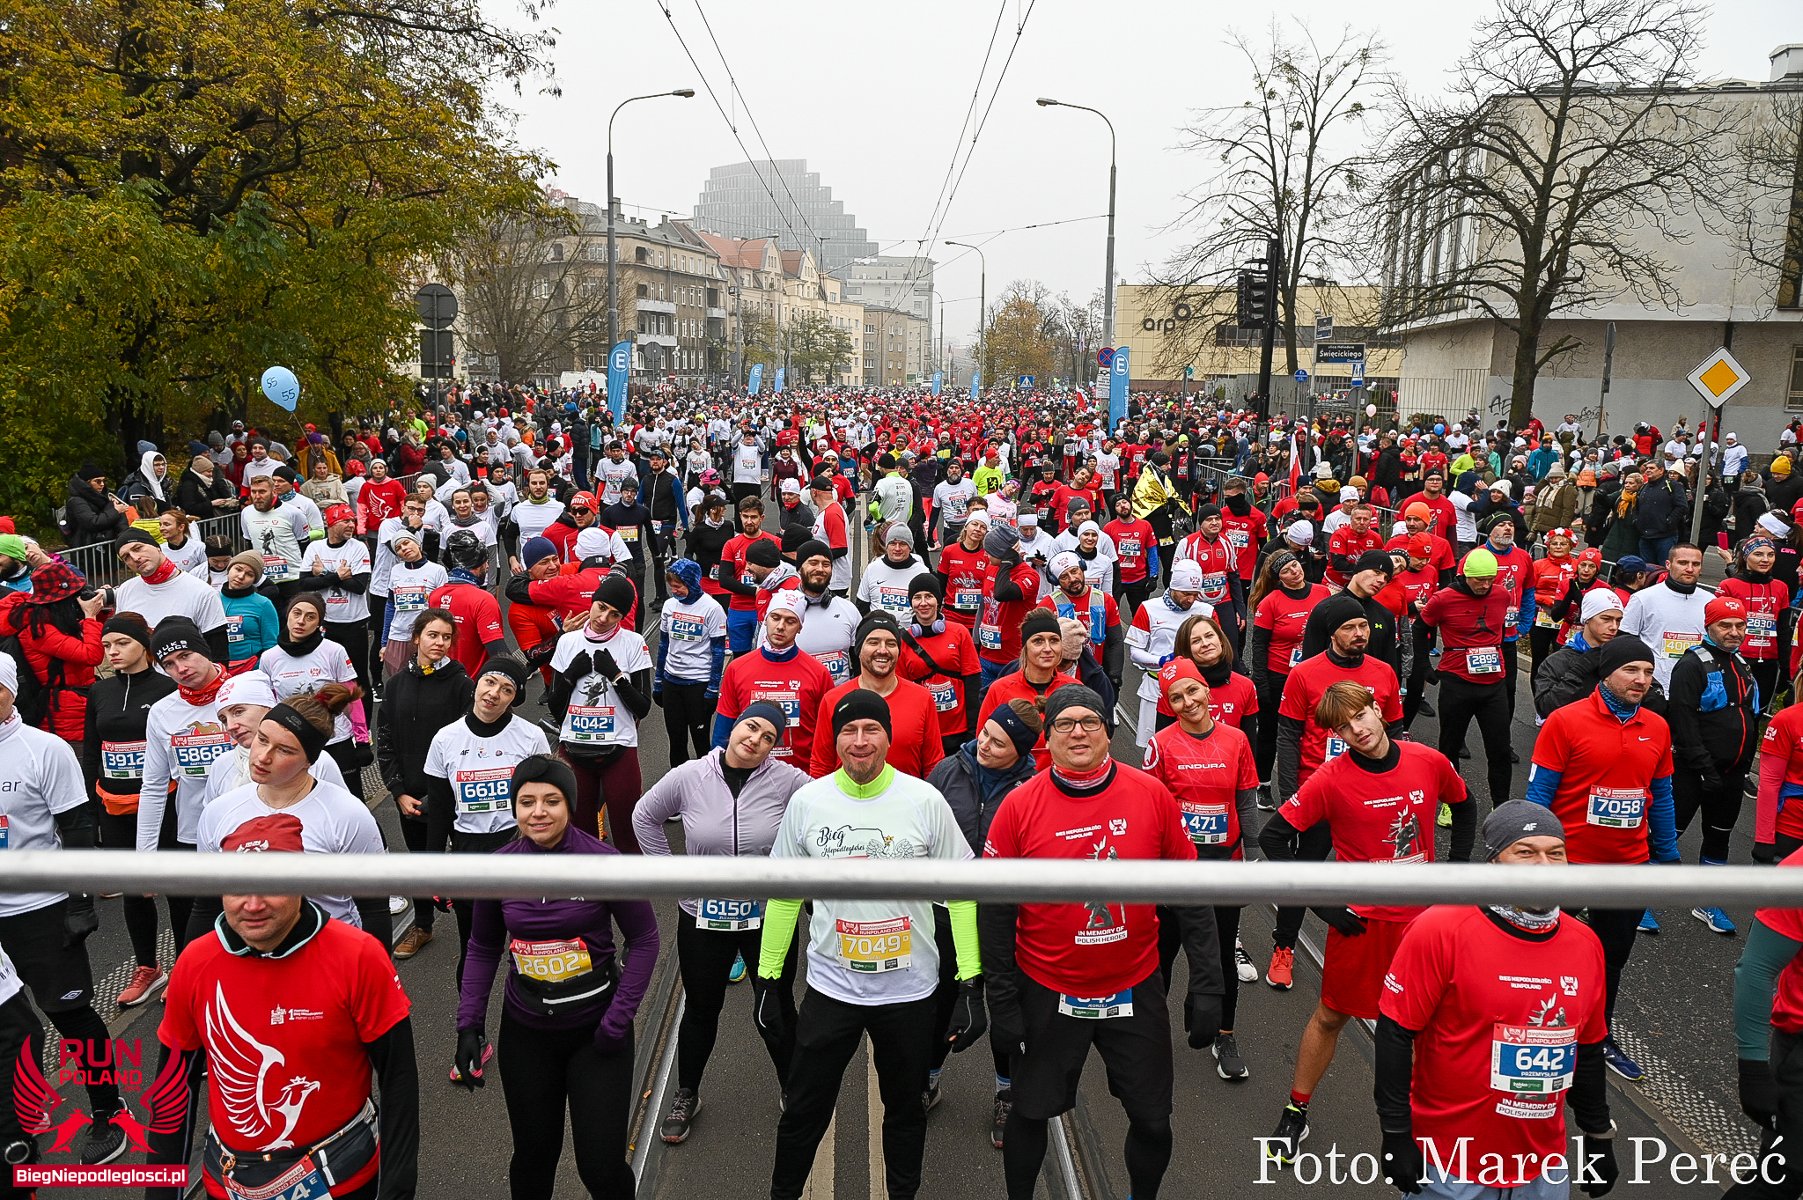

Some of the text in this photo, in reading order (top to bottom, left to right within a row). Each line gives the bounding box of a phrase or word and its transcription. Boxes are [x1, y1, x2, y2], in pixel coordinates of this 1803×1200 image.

[1143, 317, 1175, 335] arp
[1320, 348, 1363, 359] Święcickiego
[1116, 357, 1125, 372] E
[281, 389, 296, 402] 55
[397, 594, 420, 602] 2564
[883, 594, 906, 604] 2943
[674, 621, 695, 632] 2114
[1747, 618, 1773, 629] 2830
[982, 630, 994, 641] 289
[1472, 655, 1497, 665] 2895
[572, 717, 608, 729] 4042
[107, 752, 145, 767] 3912
[178, 746, 224, 763] 5868
[464, 781, 509, 798] 6618
[1597, 799, 1641, 815] 7058
[1189, 816, 1217, 830] 471
[1523, 822, 1537, 831] 4F
[817, 827, 844, 847] Bieg
[706, 899, 751, 917] 6150
[1077, 933, 1127, 944] POLISH HEROES
[1087, 928, 1114, 936] MEMORY
[845, 936, 901, 954] 7049
[512, 954, 581, 976] 2602
[1515, 1048, 1564, 1071] 642
[1499, 1106, 1526, 1115] POLISH
